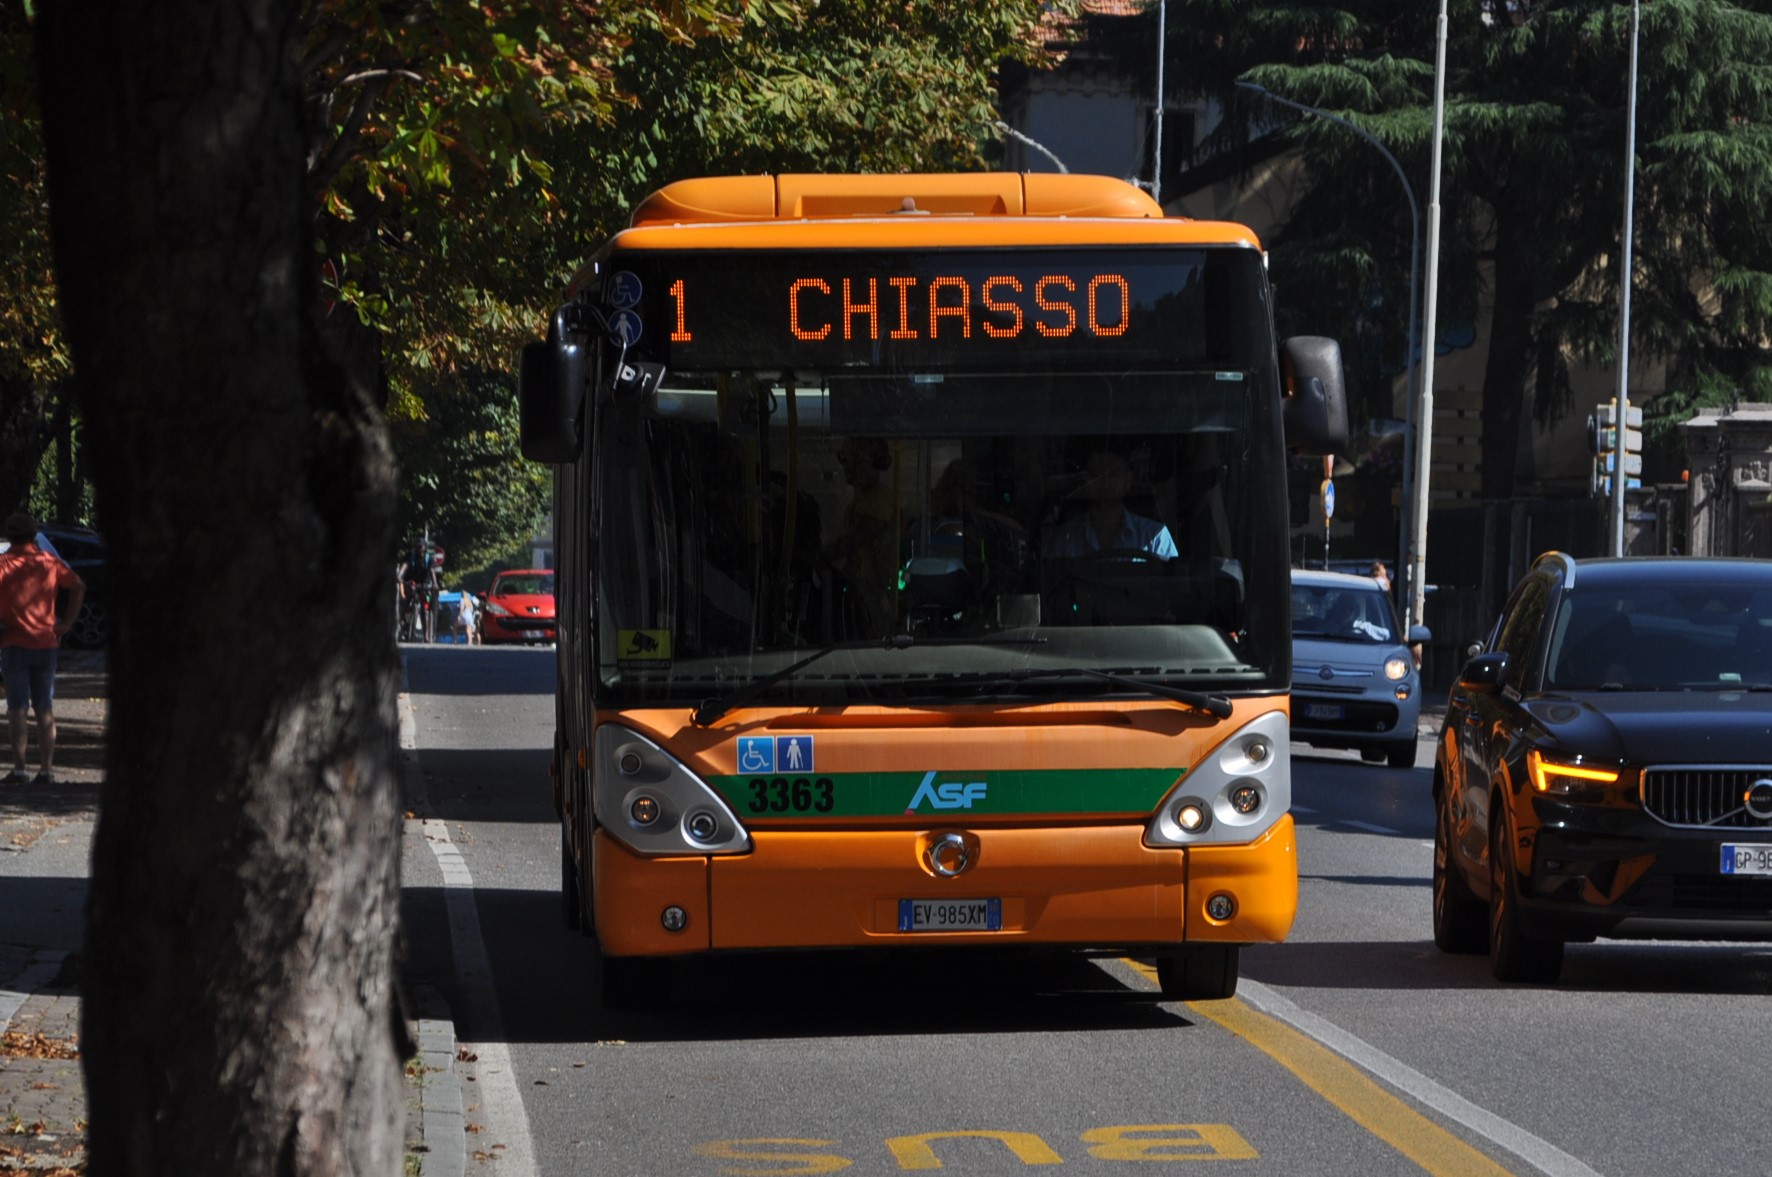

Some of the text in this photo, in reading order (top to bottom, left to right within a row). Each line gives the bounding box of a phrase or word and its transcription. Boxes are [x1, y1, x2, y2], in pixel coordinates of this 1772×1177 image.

[669, 274, 1129, 342] 1 CHIASSO
[749, 777, 835, 813] 3363
